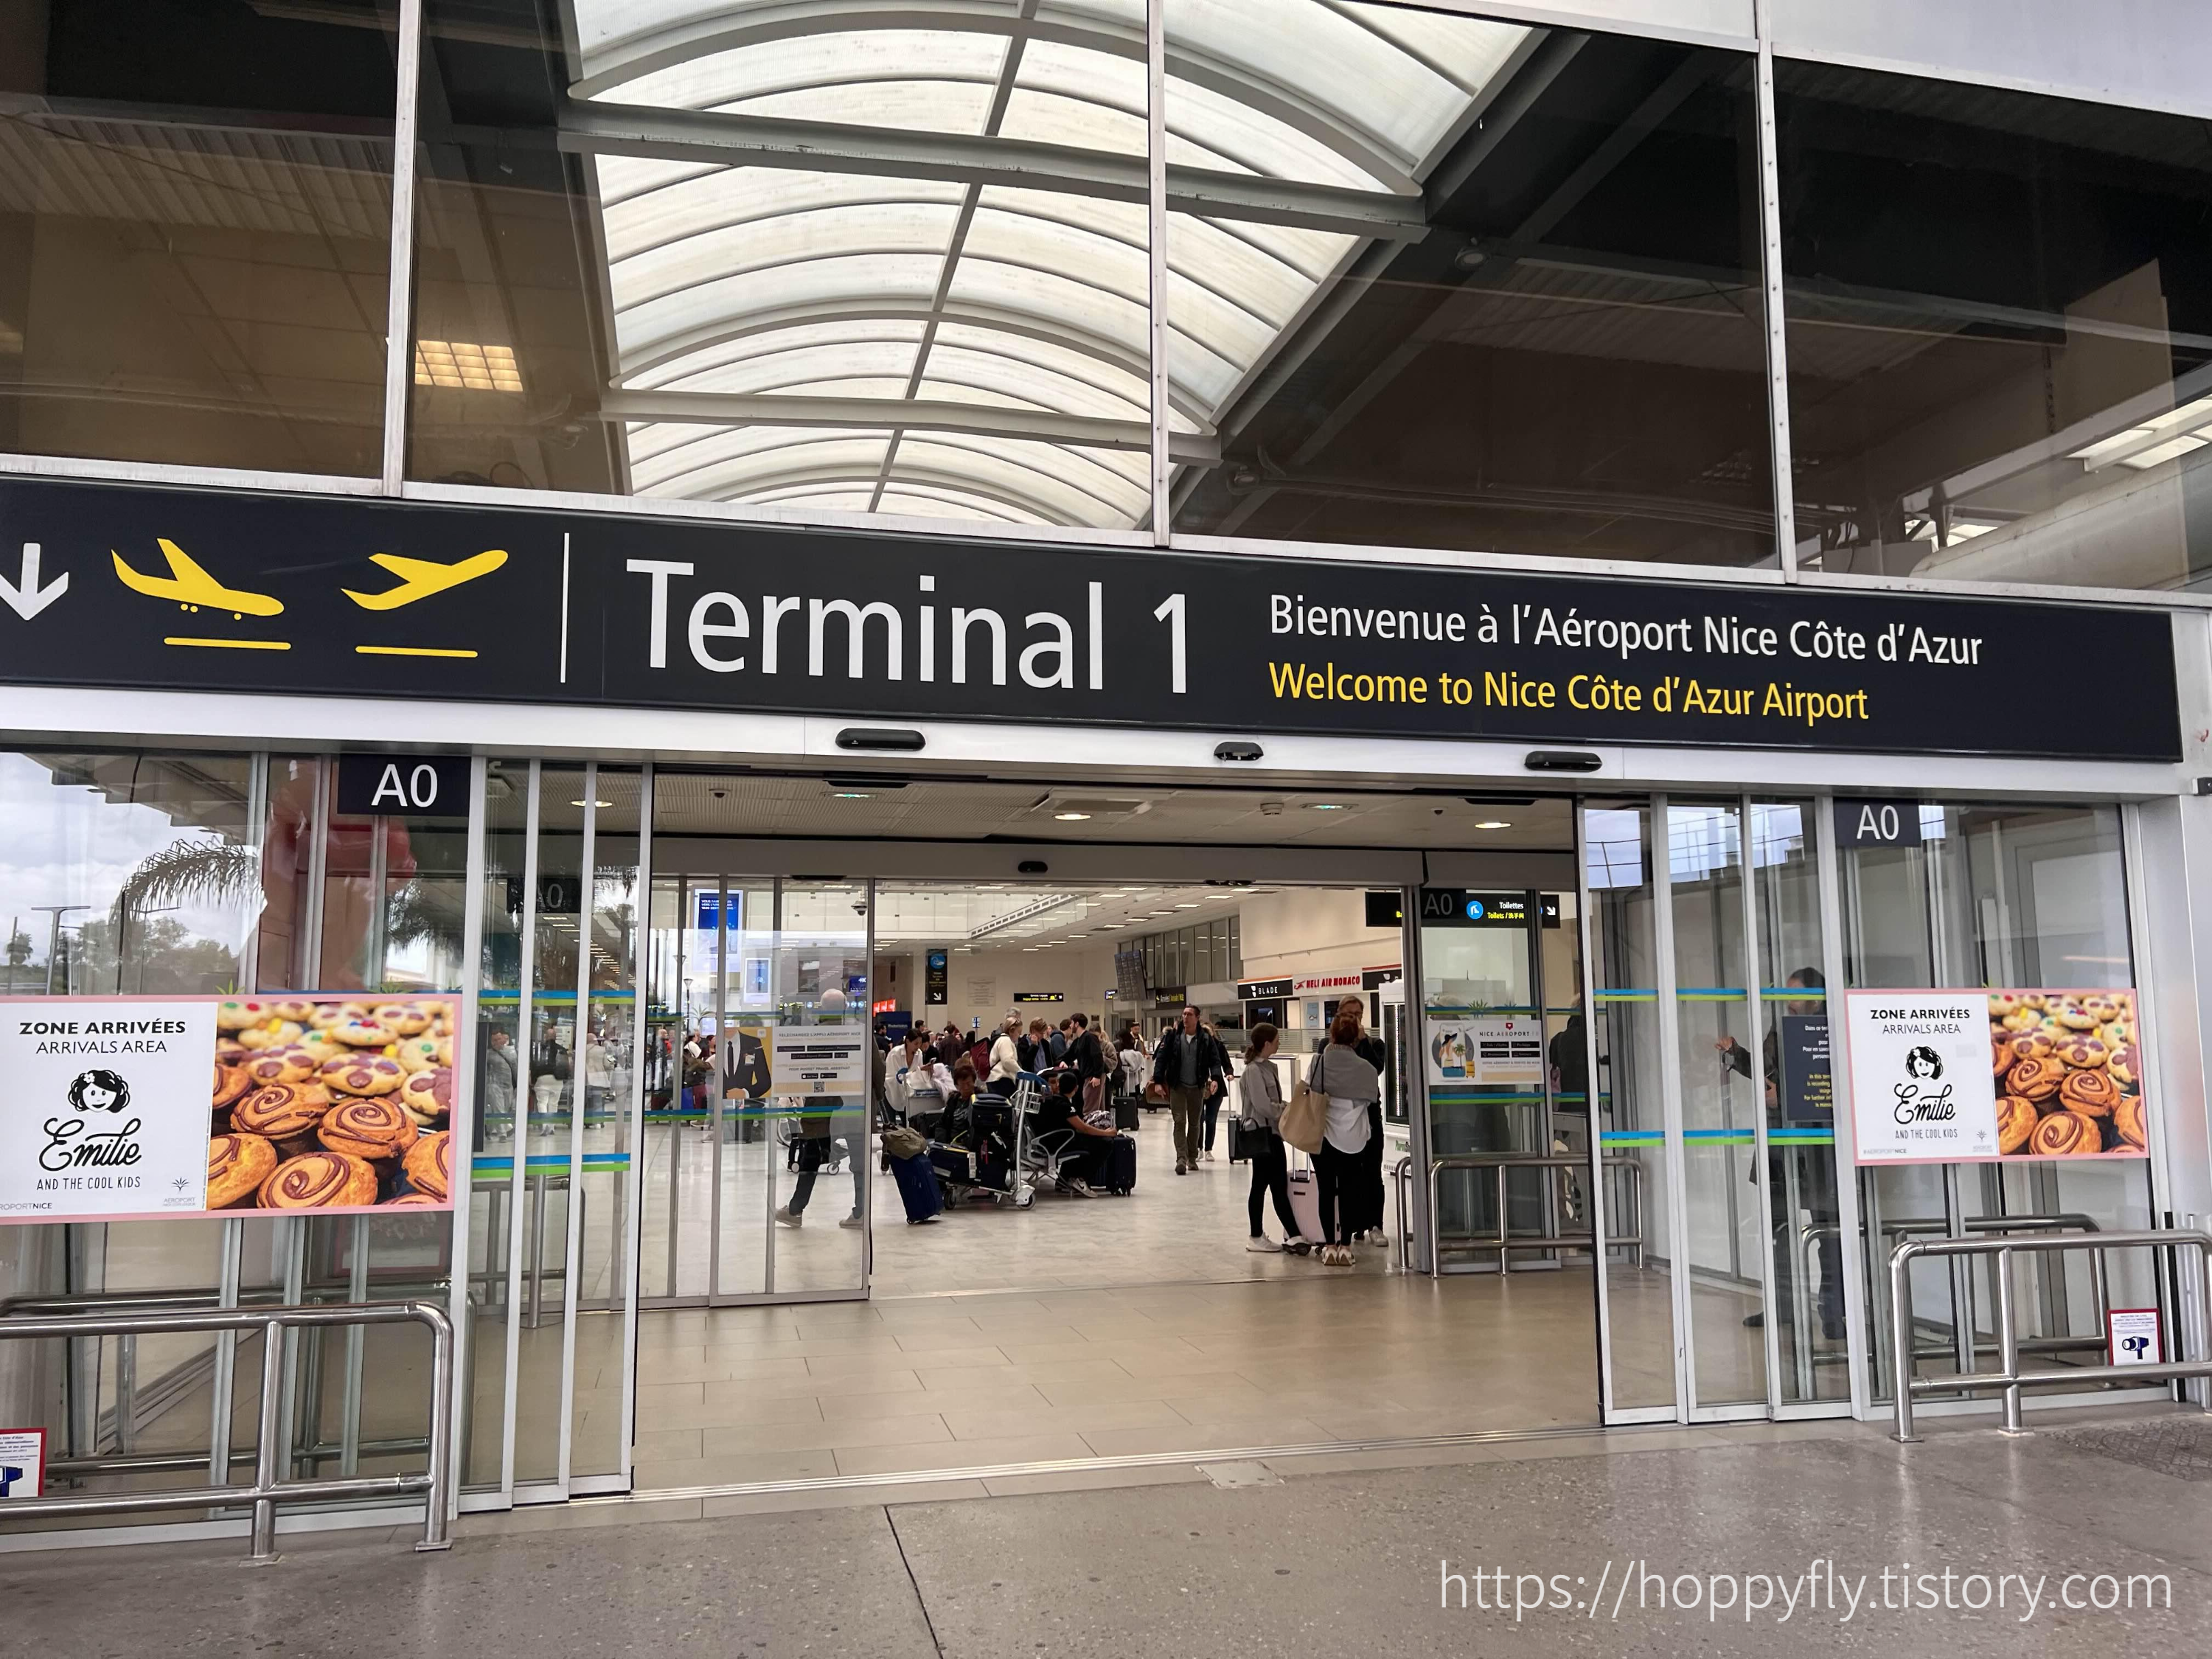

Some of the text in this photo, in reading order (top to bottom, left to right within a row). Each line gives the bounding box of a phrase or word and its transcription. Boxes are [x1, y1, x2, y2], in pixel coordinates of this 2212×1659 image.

[626, 558, 1186, 694] Terminal 1
[1271, 594, 1983, 665] Bienvenue à l'Aéroport Nice Côte d'Azur
[1268, 661, 1869, 727] Welcome to Nice Côte d'Azur Airport
[371, 764, 438, 807] A0
[1856, 804, 1899, 841] A0
[1423, 893, 1453, 916] A0
[1499, 901, 1524, 909] Toilettes
[1306, 975, 1360, 989] HELI AIR MONACO
[1258, 986, 1279, 995] BLADE
[1870, 1006, 1970, 1020] ZONE ARRIVÉES
[19, 1018, 186, 1034] ZONE ARRIVÉES
[1882, 1023, 1961, 1034] ARRIVALS AREA
[36, 1040, 167, 1054] ARRIVALS AREA
[1893, 1083, 1956, 1124] Emilie
[1895, 1129, 1958, 1139] AND THE COOL KIDS
[38, 1117, 142, 1172] Emilie
[36, 1176, 141, 1191] AND THE COOL KIDS
